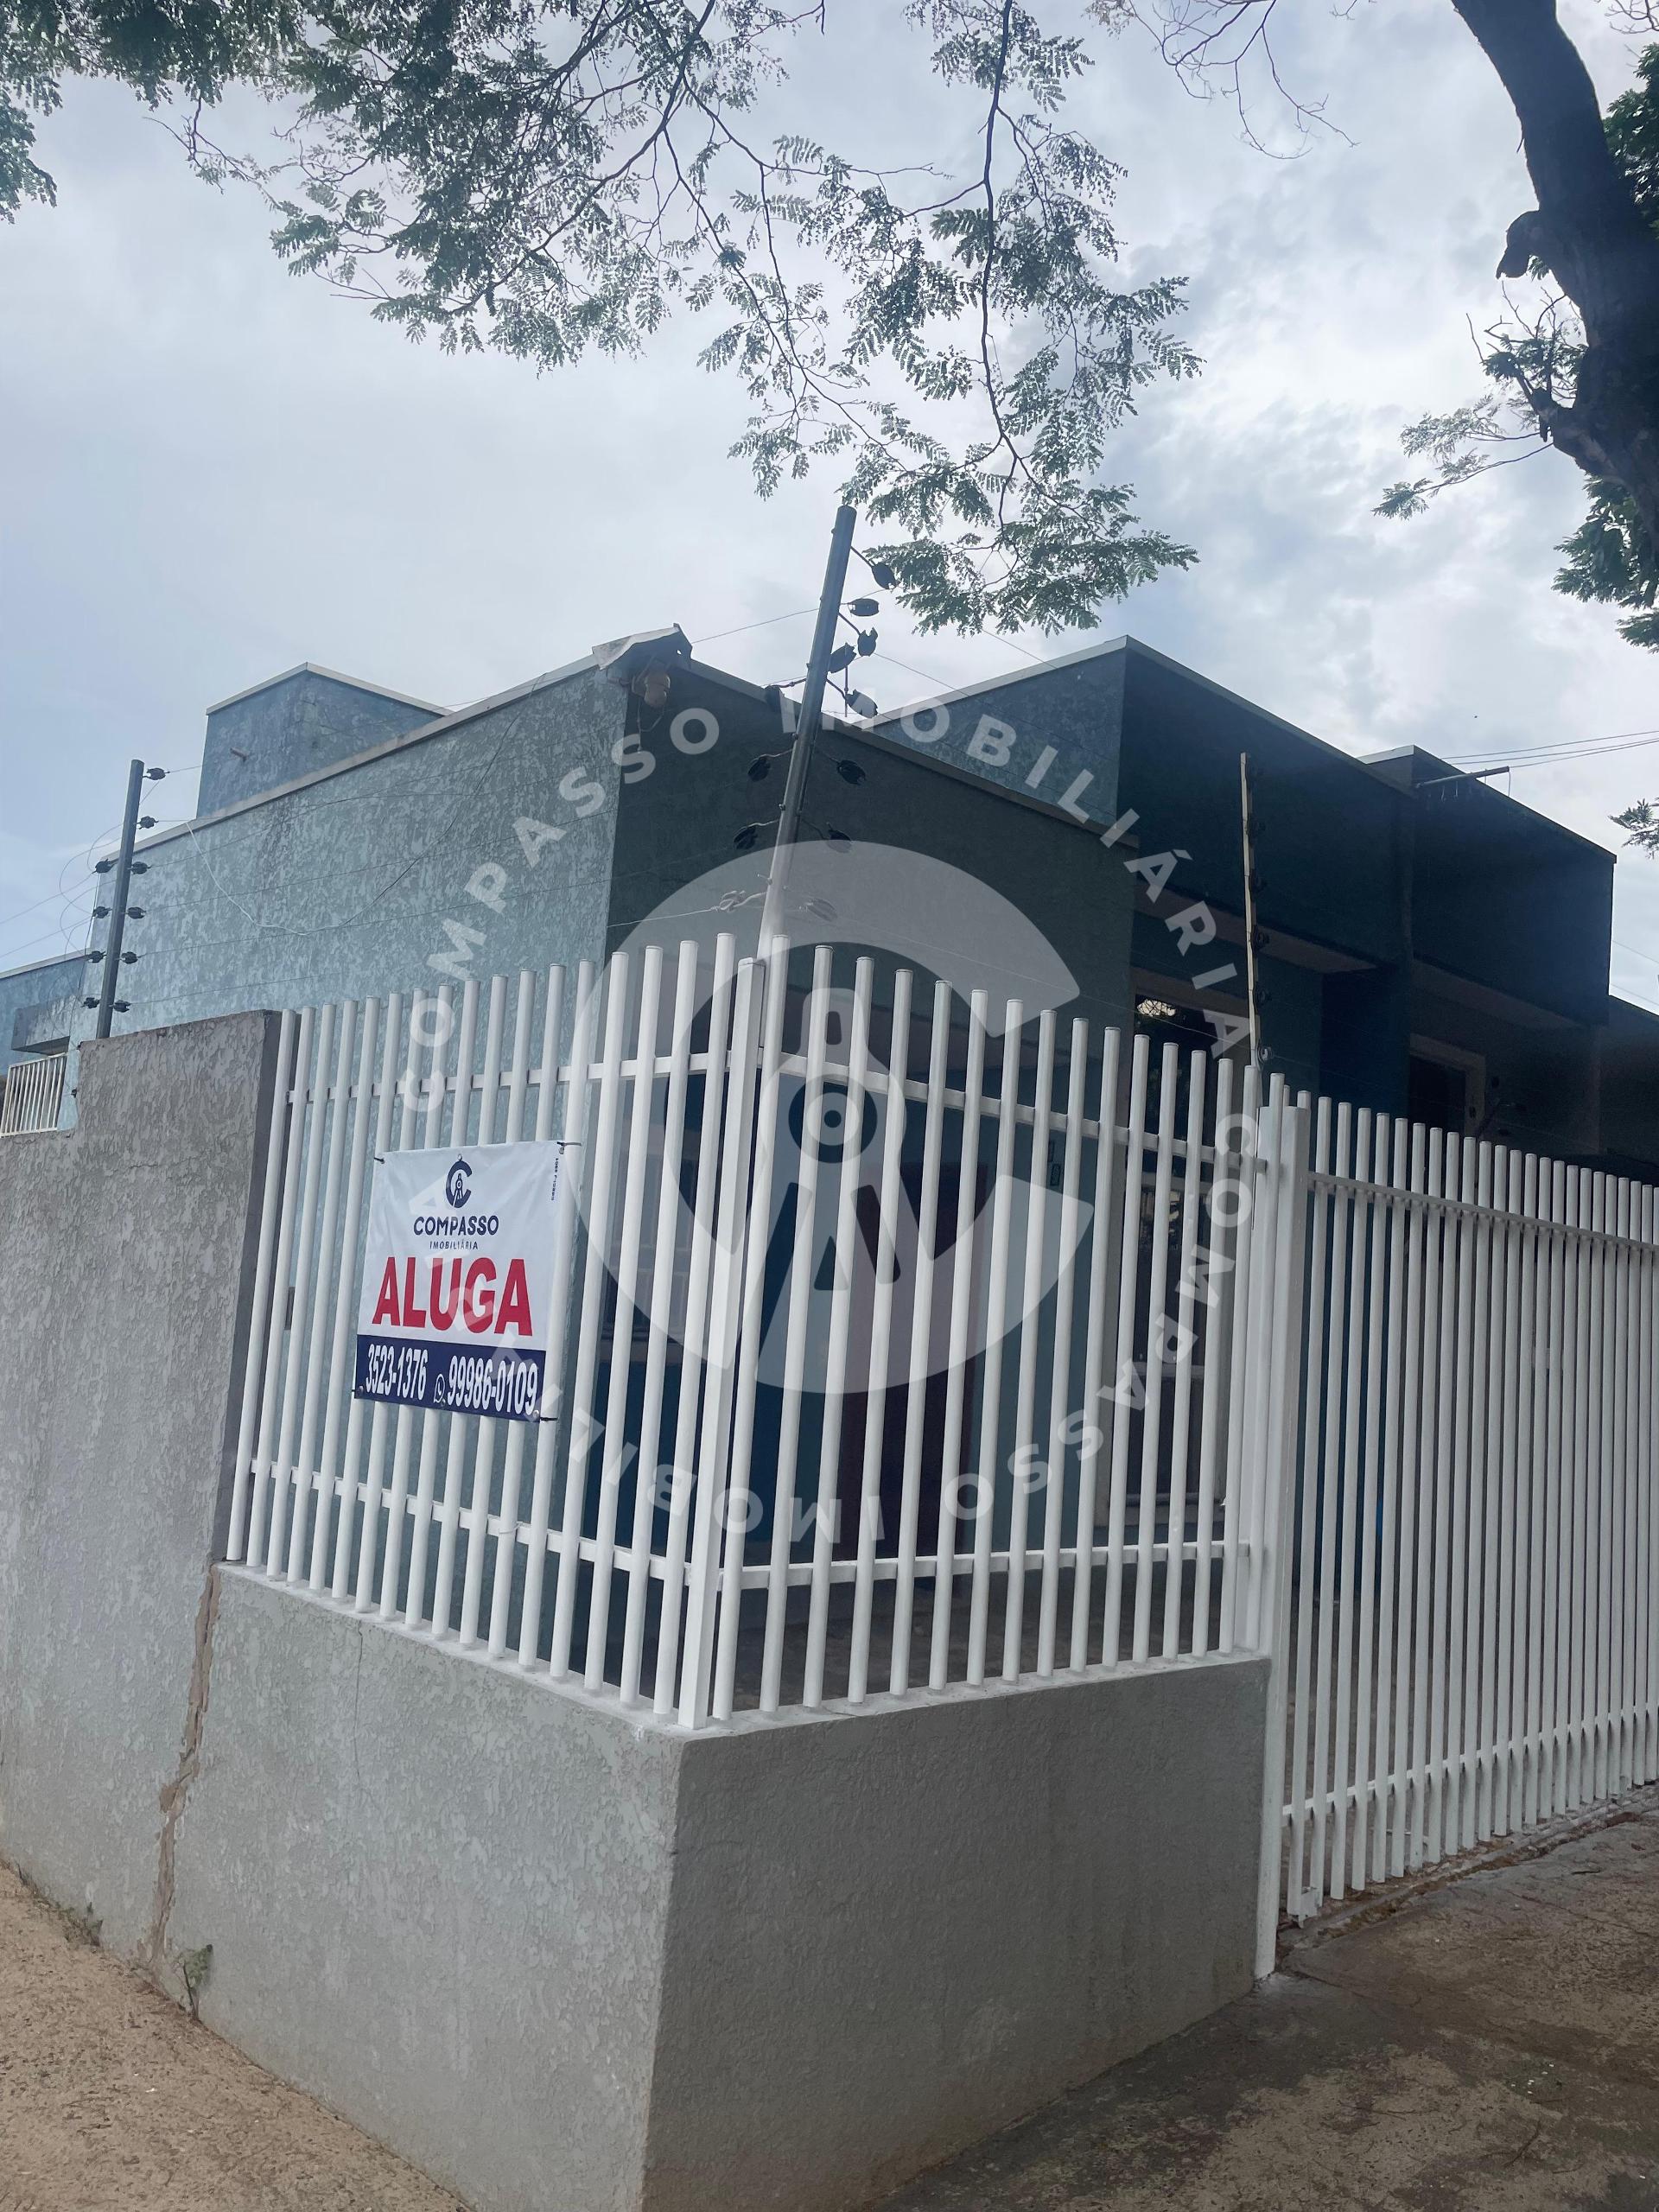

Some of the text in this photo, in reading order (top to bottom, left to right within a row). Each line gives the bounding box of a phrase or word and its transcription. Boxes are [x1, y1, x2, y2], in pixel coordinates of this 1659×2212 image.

[413, 1215, 499, 1236] COMPASSO
[429, 1239, 479, 1250] IMOBILIÁRIA
[372, 1256, 533, 1337] ALUGA
[365, 1344, 539, 1416] 3523-1376 99986-0109
